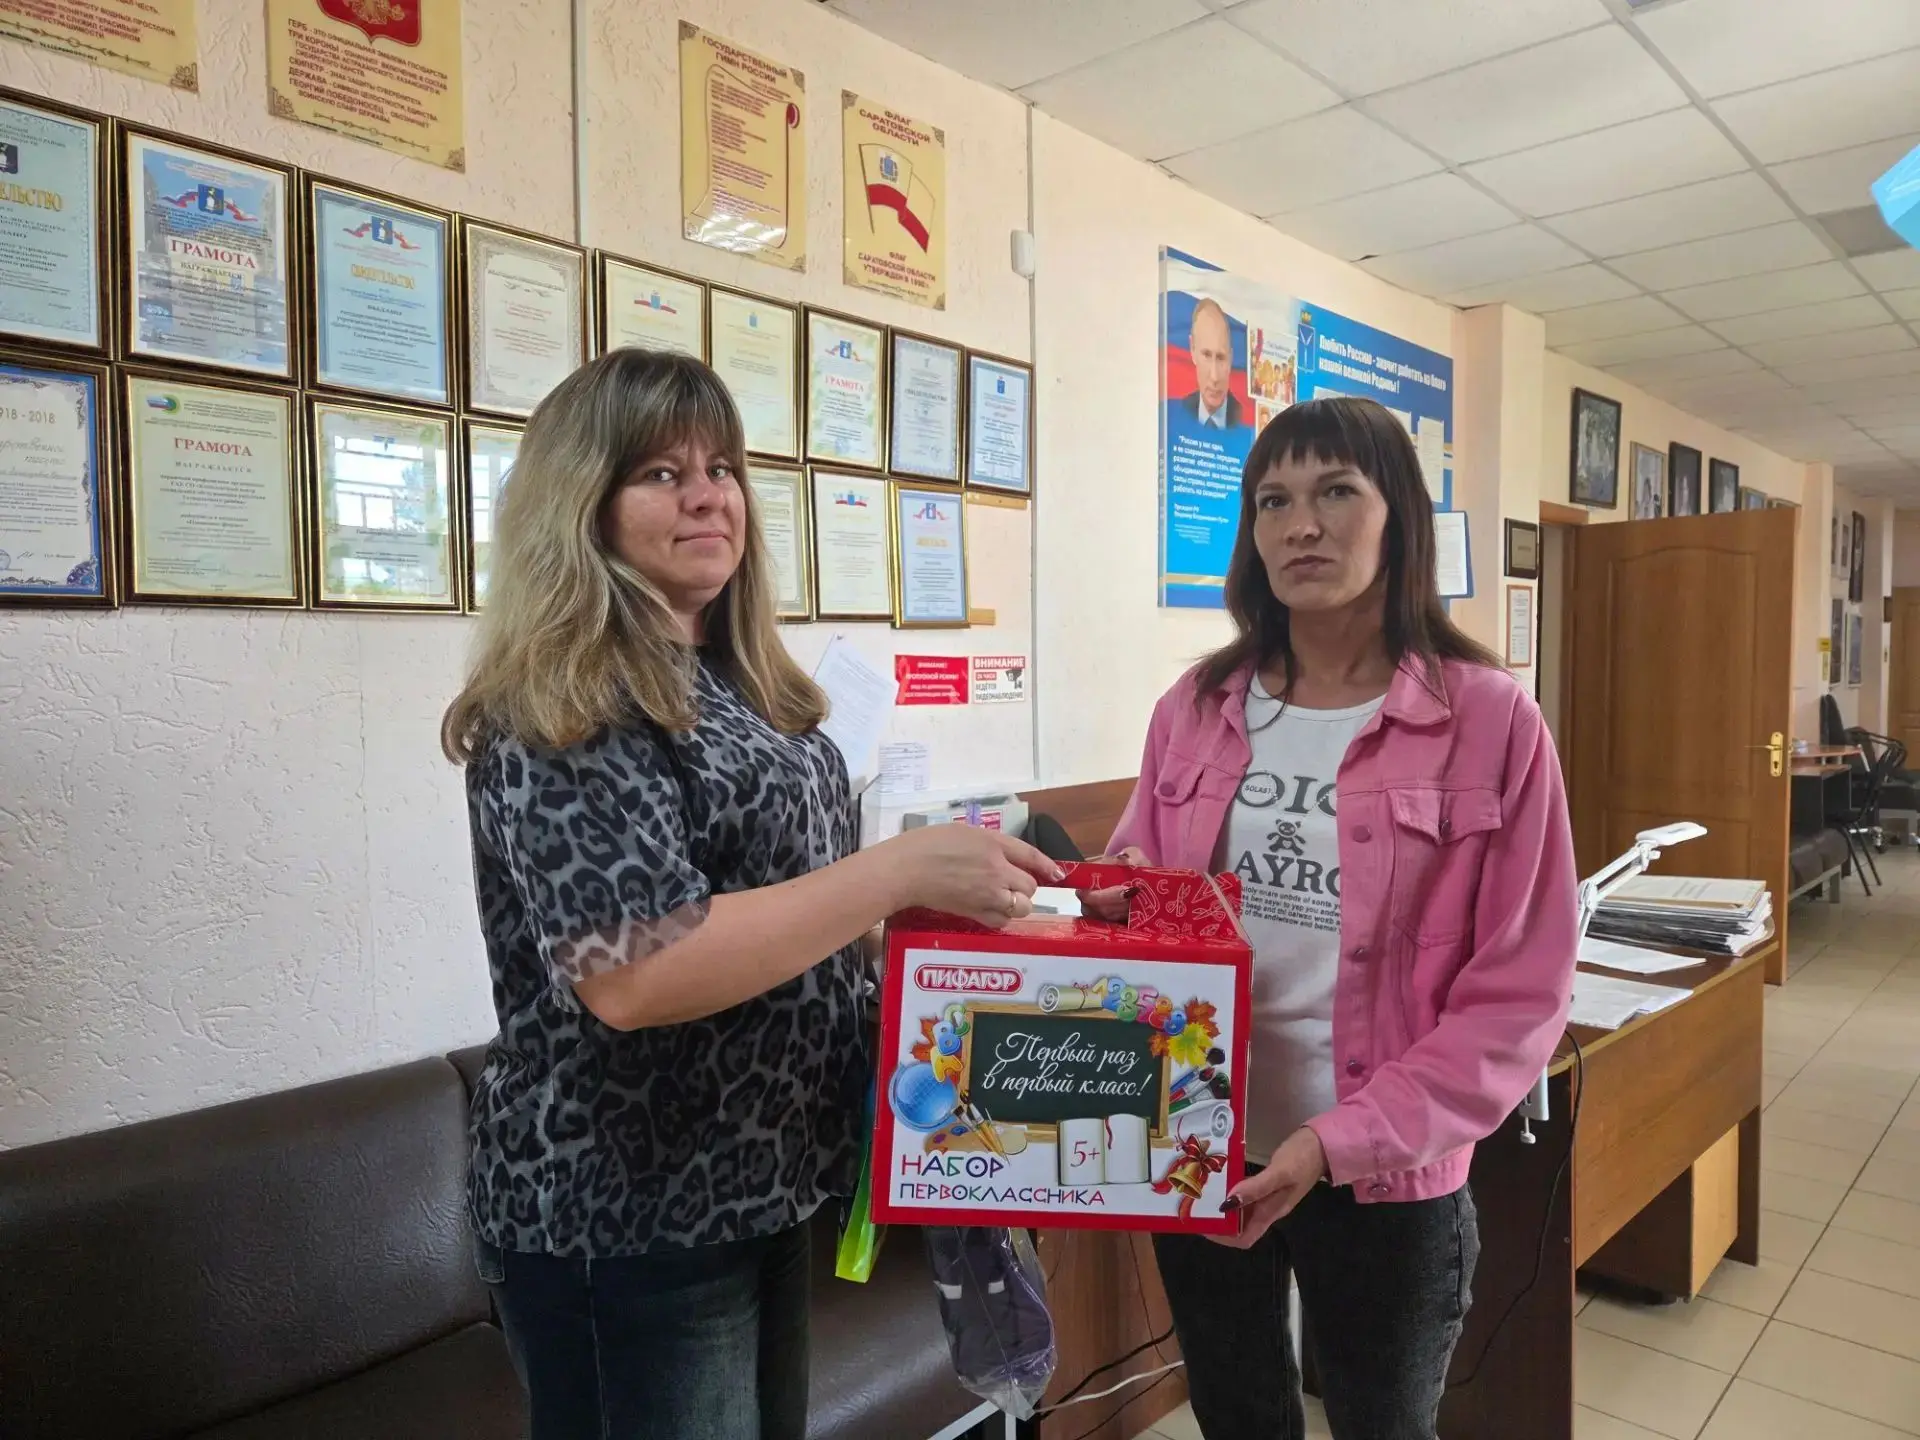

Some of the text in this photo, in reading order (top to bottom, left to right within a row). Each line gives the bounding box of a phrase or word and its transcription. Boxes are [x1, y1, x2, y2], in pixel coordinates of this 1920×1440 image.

[288, 18, 308, 31] ГЕРБ
[288, 29, 303, 40] ТРИ
[305, 36, 339, 53] КОРОНЫ
[288, 57, 324, 72] СКИПЕТР
[702, 35, 787, 78] ГОСУДАРСТВЕННЫЙ
[716, 51, 776, 83] ГИМН РОССИИ
[288, 66, 327, 84] ДЕРЖАВА
[289, 78, 325, 94] ГЕОРГИЙ
[326, 89, 384, 114] ПОБЕДОНОСЕЦ
[859, 108, 931, 143] САРАТОВСКОЙ
[884, 110, 912, 126] ФЛАГ
[872, 122, 919, 146] ОБЛАСТИ
[171, 239, 256, 269] ГРАМОТА
[858, 252, 936, 282] САРАТОВСКОЙ ОБЛАСТИ
[1319, 334, 1346, 357] Любить
[1347, 344, 1373, 366] Россию
[1376, 356, 1398, 374] значит
[825, 375, 865, 392] ГРАМОТА
[174, 437, 253, 457] ГРАМОТА
[974, 657, 1025, 668] ВНИМАНИЕ
[921, 969, 1017, 992] ПИФАГОР
[995, 1031, 1141, 1075] Первый раз
[981, 1062, 1154, 1099] в первый класс!
[901, 1154, 1005, 1178] НАБОР
[1070, 1140, 1101, 1168] 5+
[899, 1183, 1106, 1206] ПЕРВОКЛАССНИКА
